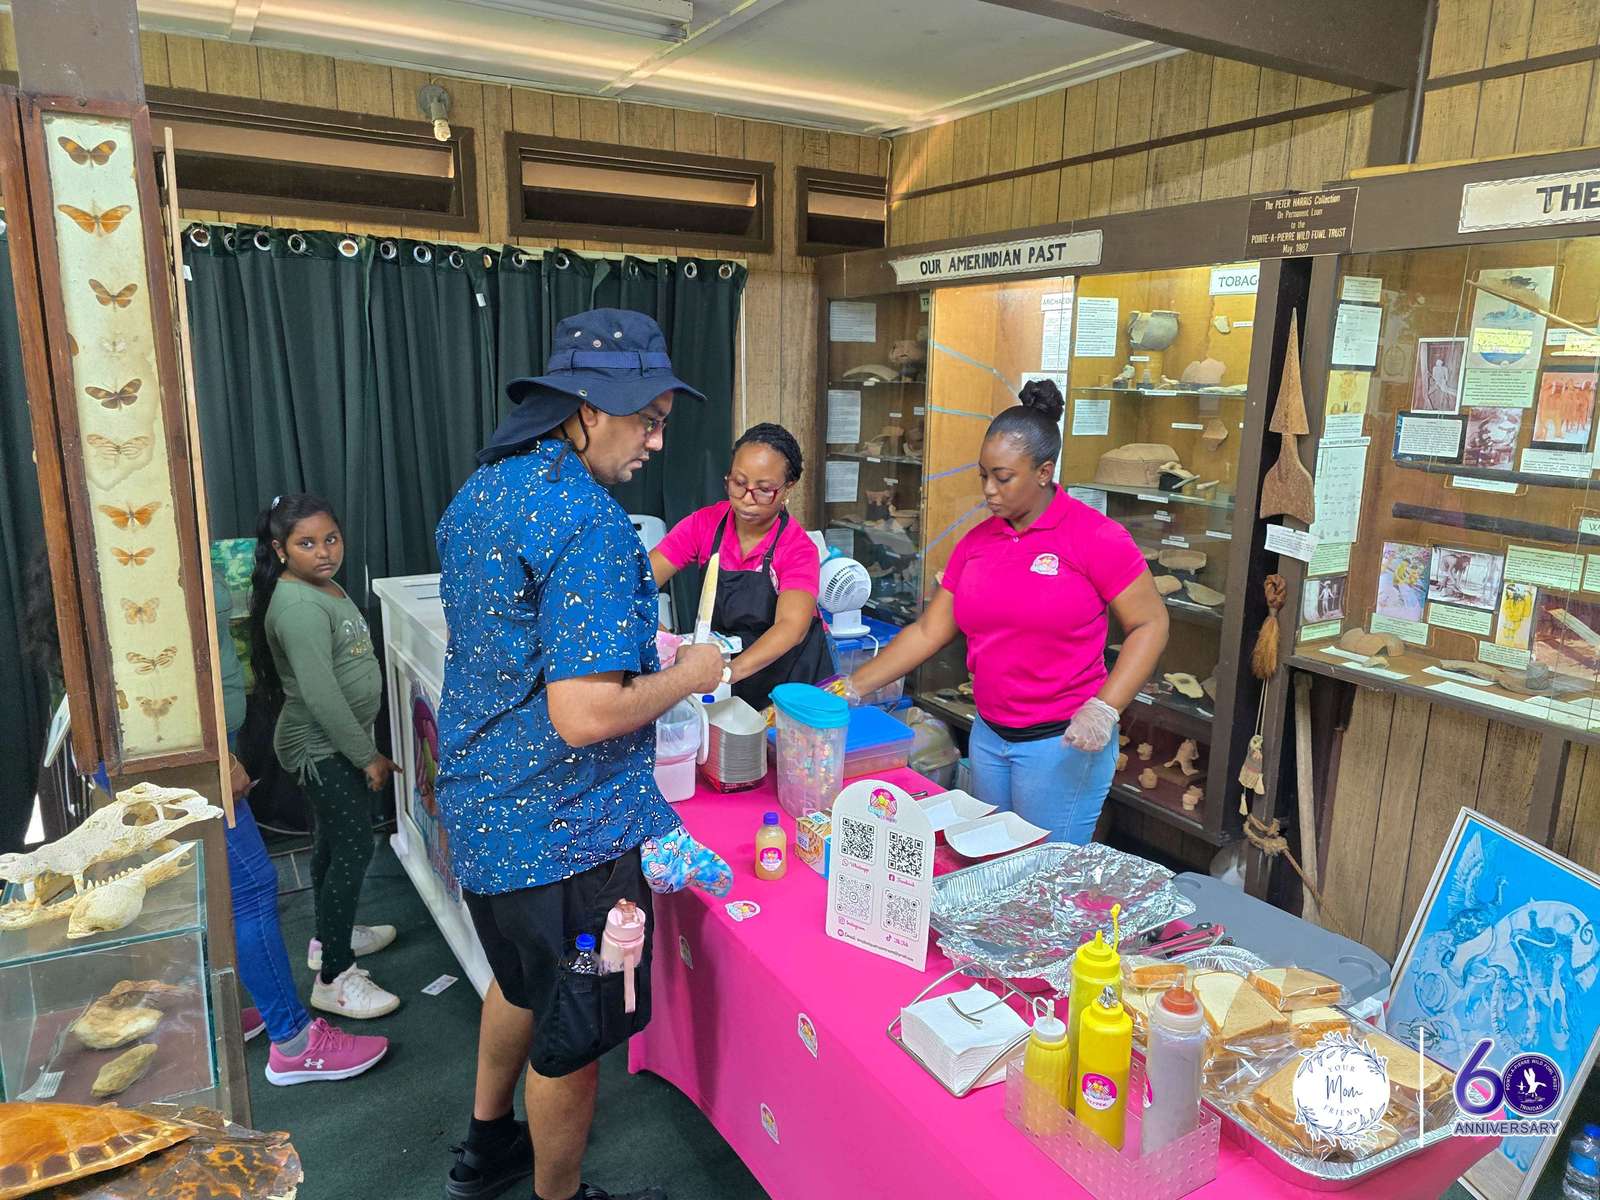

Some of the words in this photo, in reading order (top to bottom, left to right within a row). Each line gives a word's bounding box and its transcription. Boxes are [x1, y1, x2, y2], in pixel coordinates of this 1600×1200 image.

[1265, 202, 1273, 210] The
[1275, 199, 1290, 208] PETER
[1293, 196, 1312, 207] HARRIS
[1314, 194, 1340, 204] Collection
[1536, 180, 1600, 213] THE
[1311, 207, 1323, 217] Loan
[1297, 220, 1305, 228] the
[1251, 232, 1295, 243] POINTE-A-PIERRE
[1297, 231, 1309, 240] WILD
[1311, 230, 1326, 239] FOWL
[1328, 228, 1346, 237] TRUST
[1296, 243, 1309, 253] 1987
[920, 260, 941, 275] OUR
[948, 249, 1020, 272] AMERINDIAN
[1028, 243, 1066, 263] PAST
[1218, 274, 1258, 288] TOBAG
